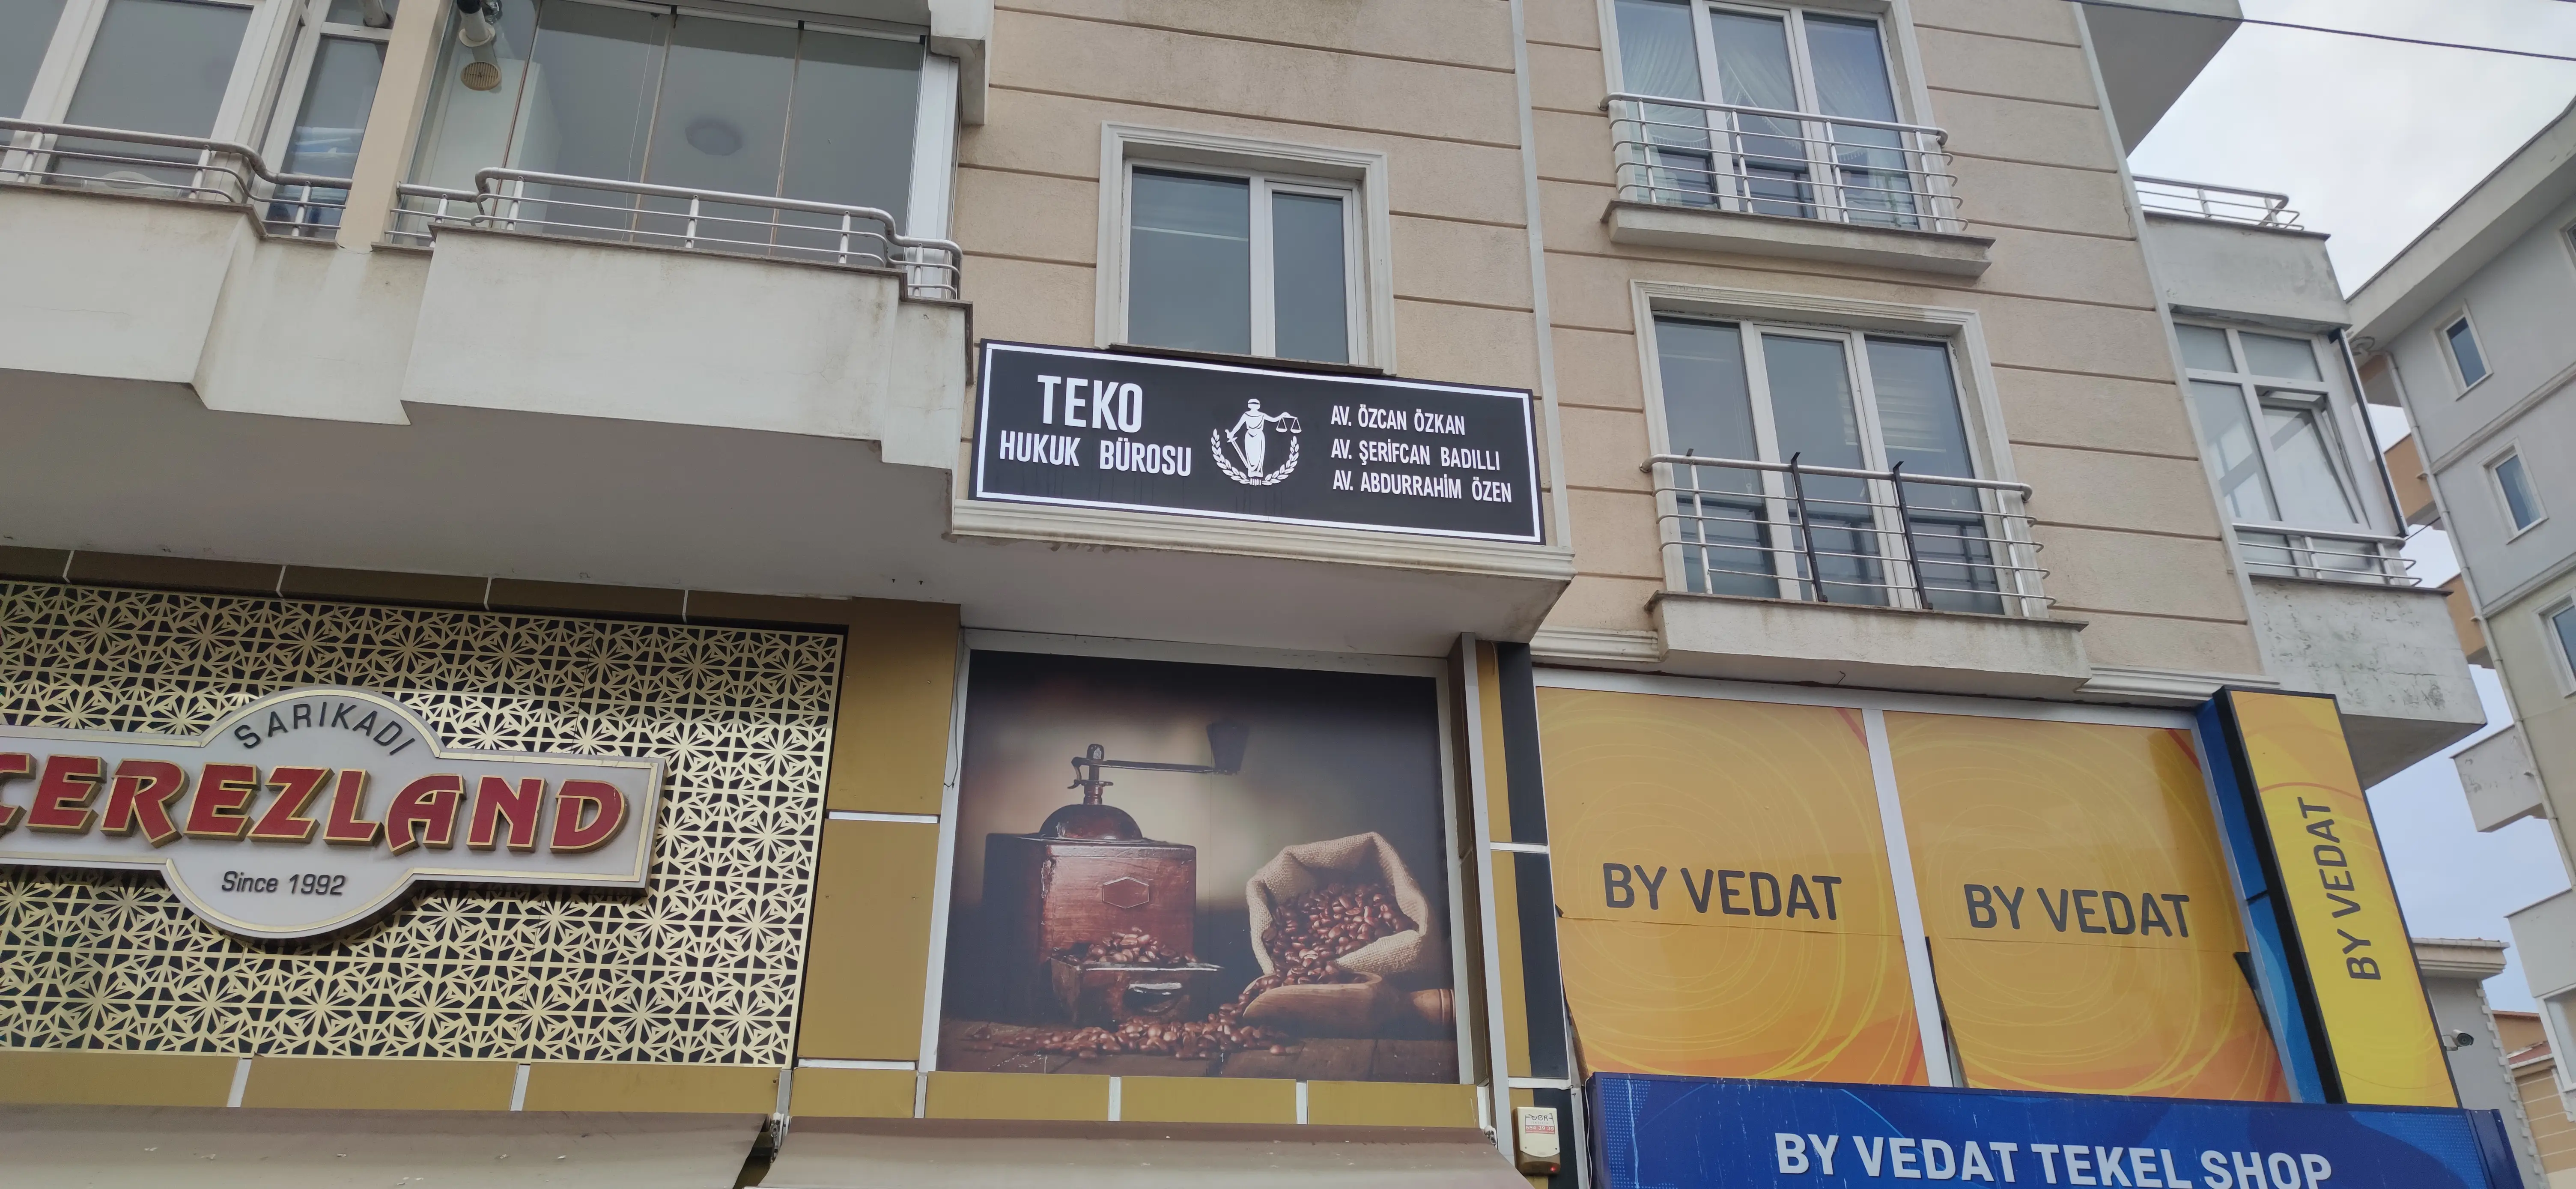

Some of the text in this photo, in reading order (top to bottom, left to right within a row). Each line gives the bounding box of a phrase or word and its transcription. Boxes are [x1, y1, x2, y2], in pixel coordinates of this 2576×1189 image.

[1037, 374, 1143, 433] TEKO
[1331, 403, 1465, 435] AV. ÖZCAN ÖZKAN
[999, 430, 1192, 477] HUKUK BÜROSU
[1331, 438, 1500, 471] AV. ŞERİFCAN BADILLI
[1333, 469, 1512, 503] AV. ABDURRAHİM ÖZEN
[234, 702, 415, 756] SARIKADI
[221, 871, 346, 896] Since 1992
[1603, 862, 1842, 920] BY VEDAT
[2297, 796, 2381, 980] BY VEDAT
[1964, 884, 2190, 938] BY VEDAT
[1775, 1132, 2332, 1189] BY VEDAT TEKEL SHOP
